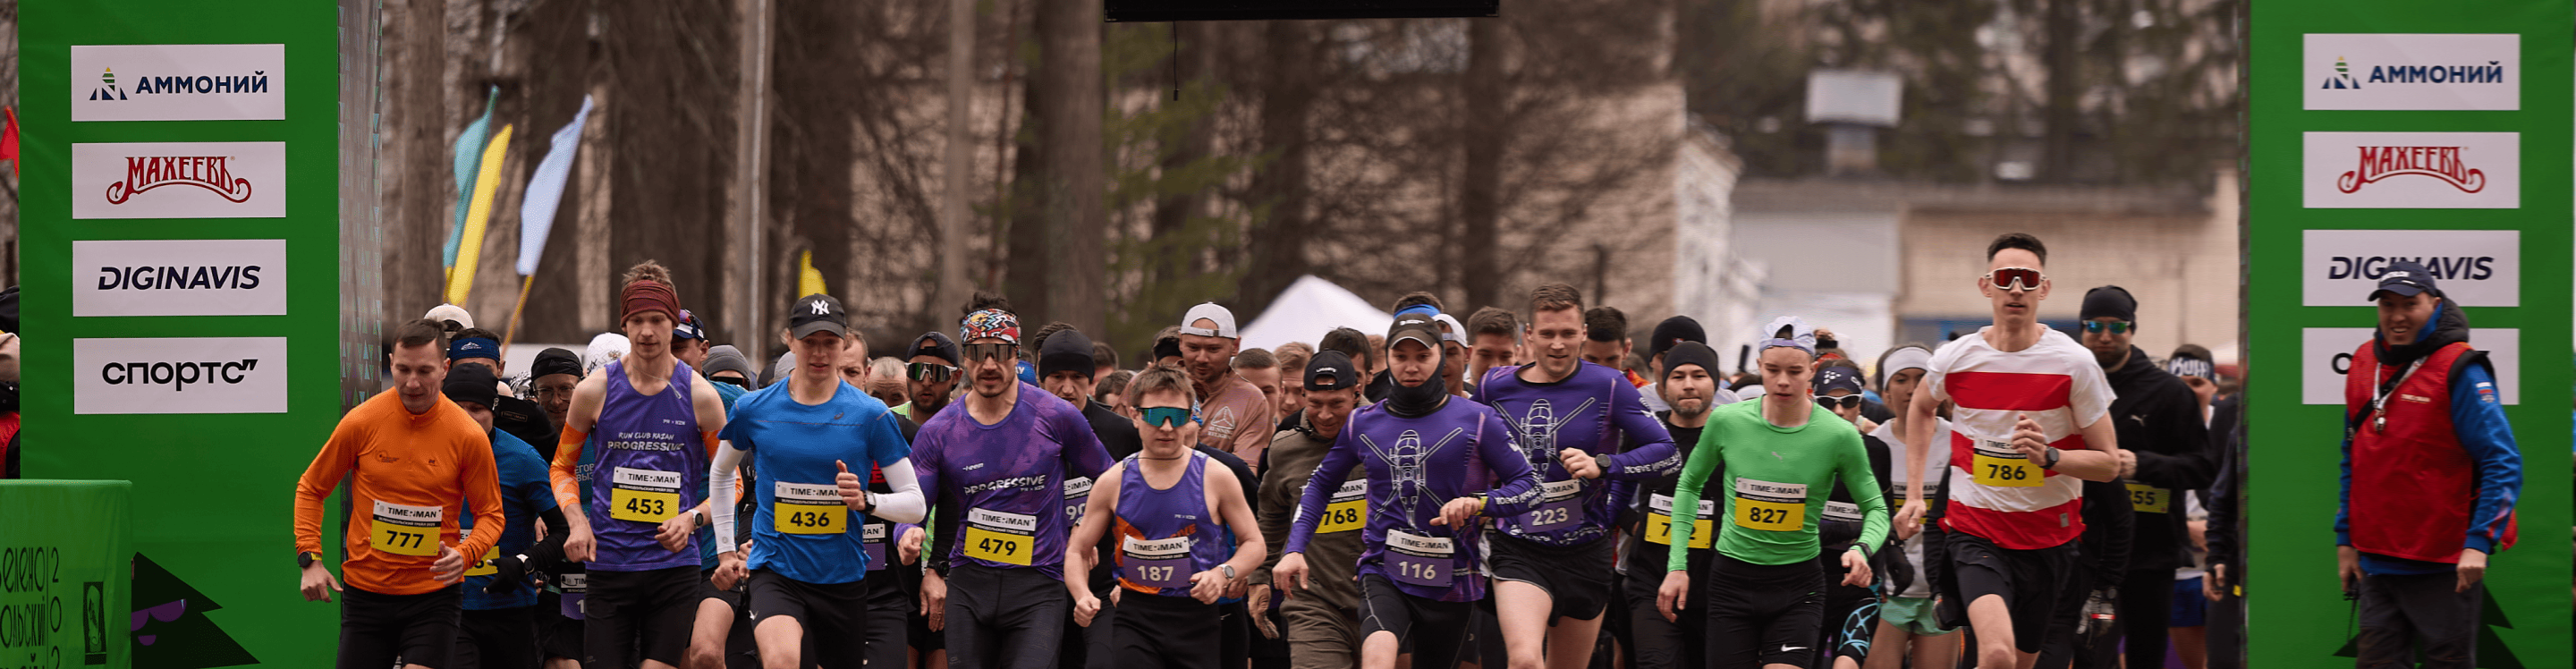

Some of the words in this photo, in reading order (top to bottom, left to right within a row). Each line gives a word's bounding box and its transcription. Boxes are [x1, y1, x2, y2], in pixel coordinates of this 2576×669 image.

[2368, 60, 2503, 83] АММОНИЙ
[135, 70, 267, 94] АММОНИЙ
[97, 265, 261, 291] DIGINAVIS
[811, 300, 830, 315] NY
[618, 432, 632, 440] RUN
[652, 433, 674, 441] KAZAN
[607, 441, 684, 452] PROGRESSIVE
[1987, 463, 2027, 480] 786
[963, 474, 1046, 495] PROGRESSIVE
[626, 497, 664, 515] 453
[1750, 506, 1788, 524] 827
[790, 512, 830, 527] 436
[1530, 507, 1569, 526] 223
[386, 529, 424, 548] 777
[979, 538, 1017, 556] 479
[1137, 565, 1174, 581] 187
[1398, 561, 1436, 580] 116
